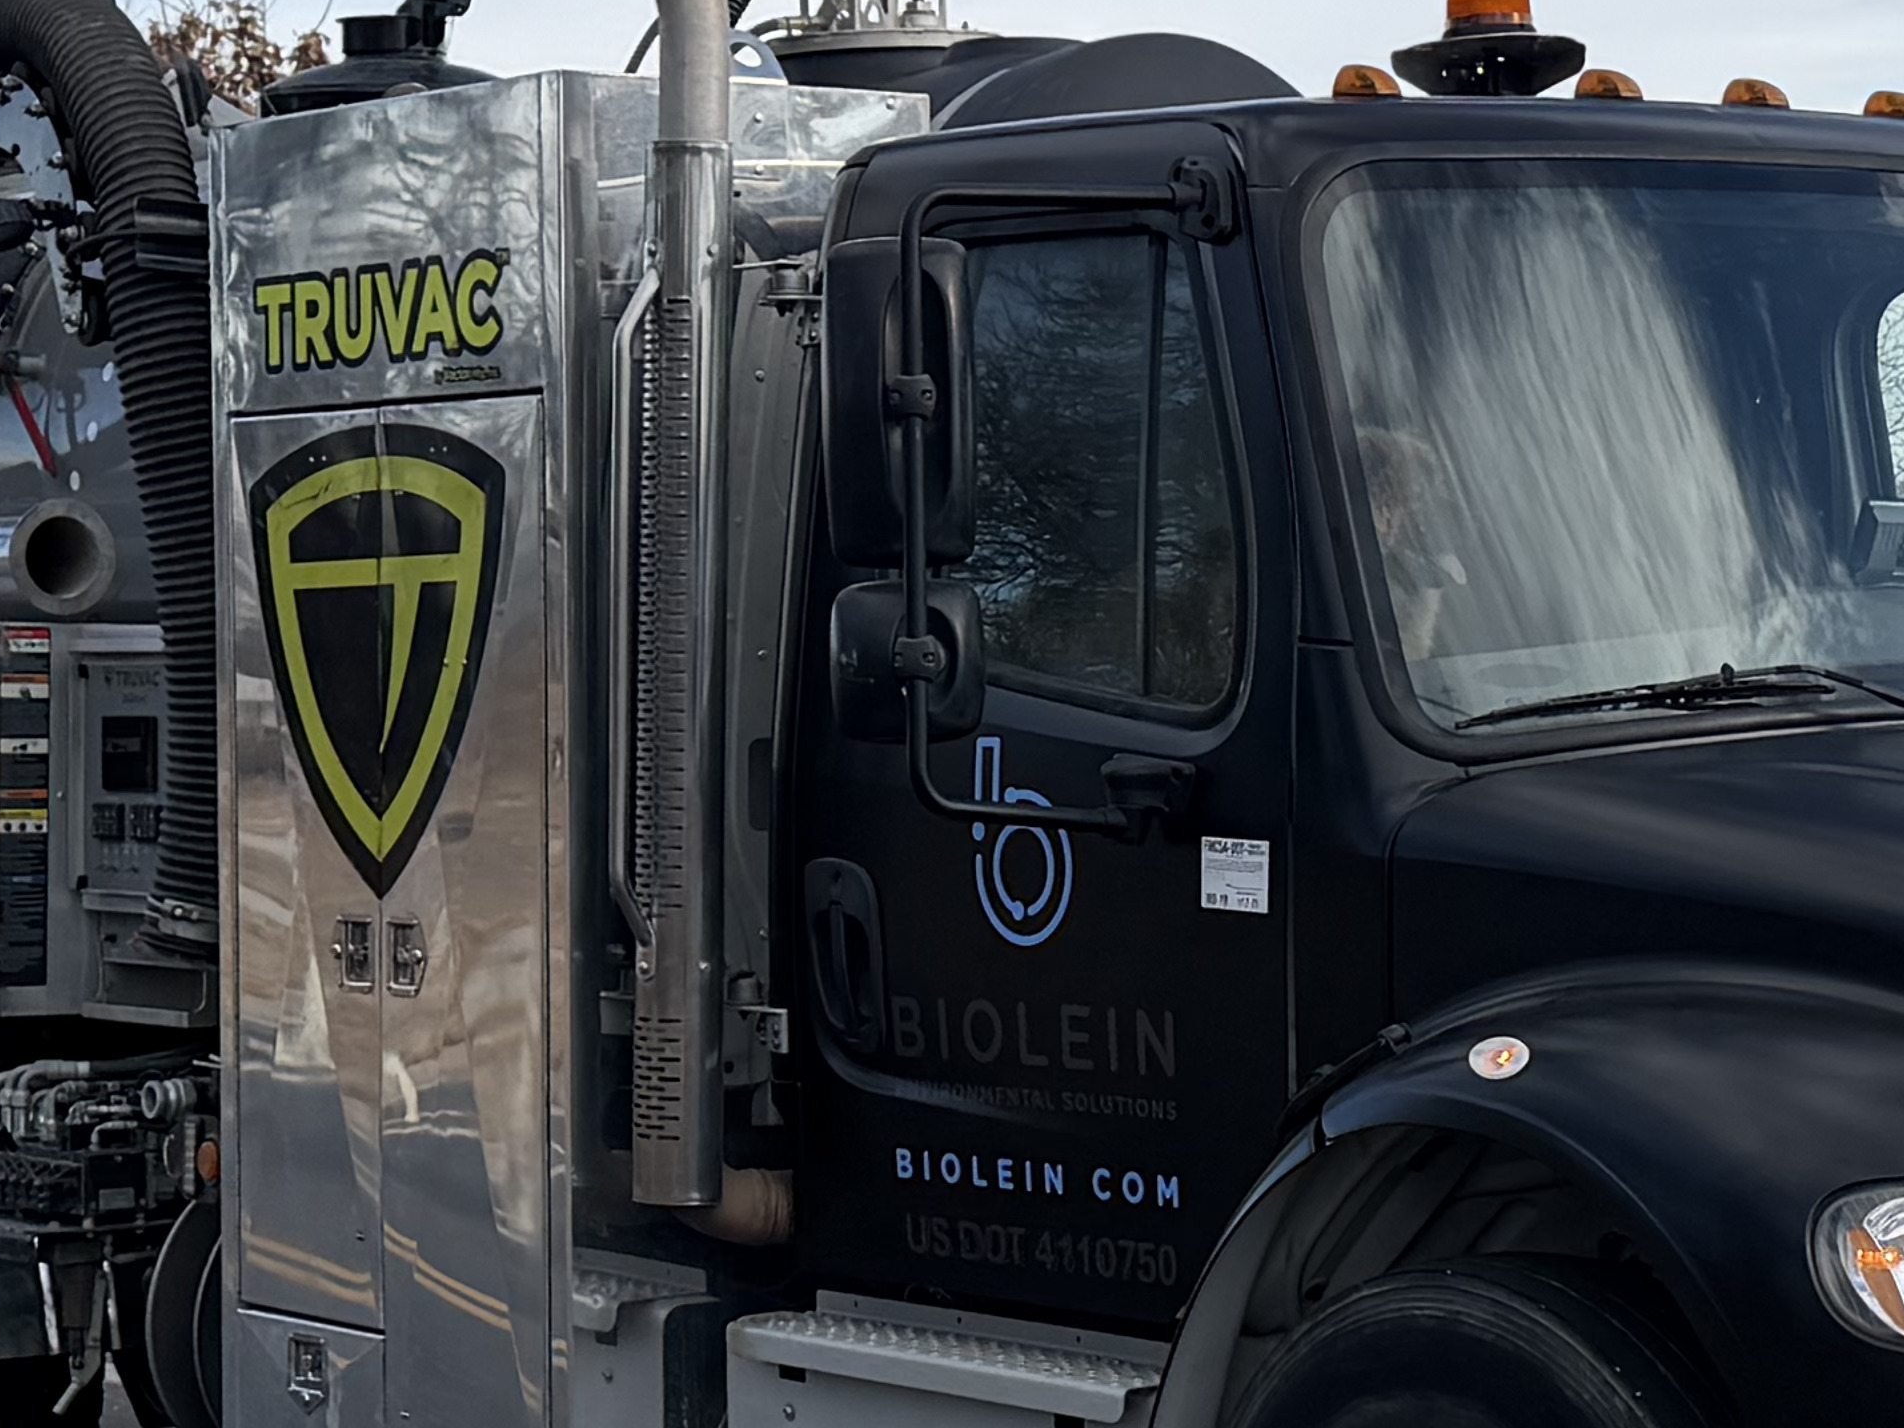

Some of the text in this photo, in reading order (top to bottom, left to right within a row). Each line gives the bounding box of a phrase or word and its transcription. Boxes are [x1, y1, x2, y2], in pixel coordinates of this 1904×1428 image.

[255, 251, 502, 371] TRUVAC
[889, 995, 1177, 1078] BIOLEIN
[897, 1078, 1178, 1122] IRONMENTAL SOLUTIONS
[894, 1147, 1181, 1209] BIOLEIN COM
[904, 1211, 953, 1259] US
[958, 1220, 1027, 1267] DOT
